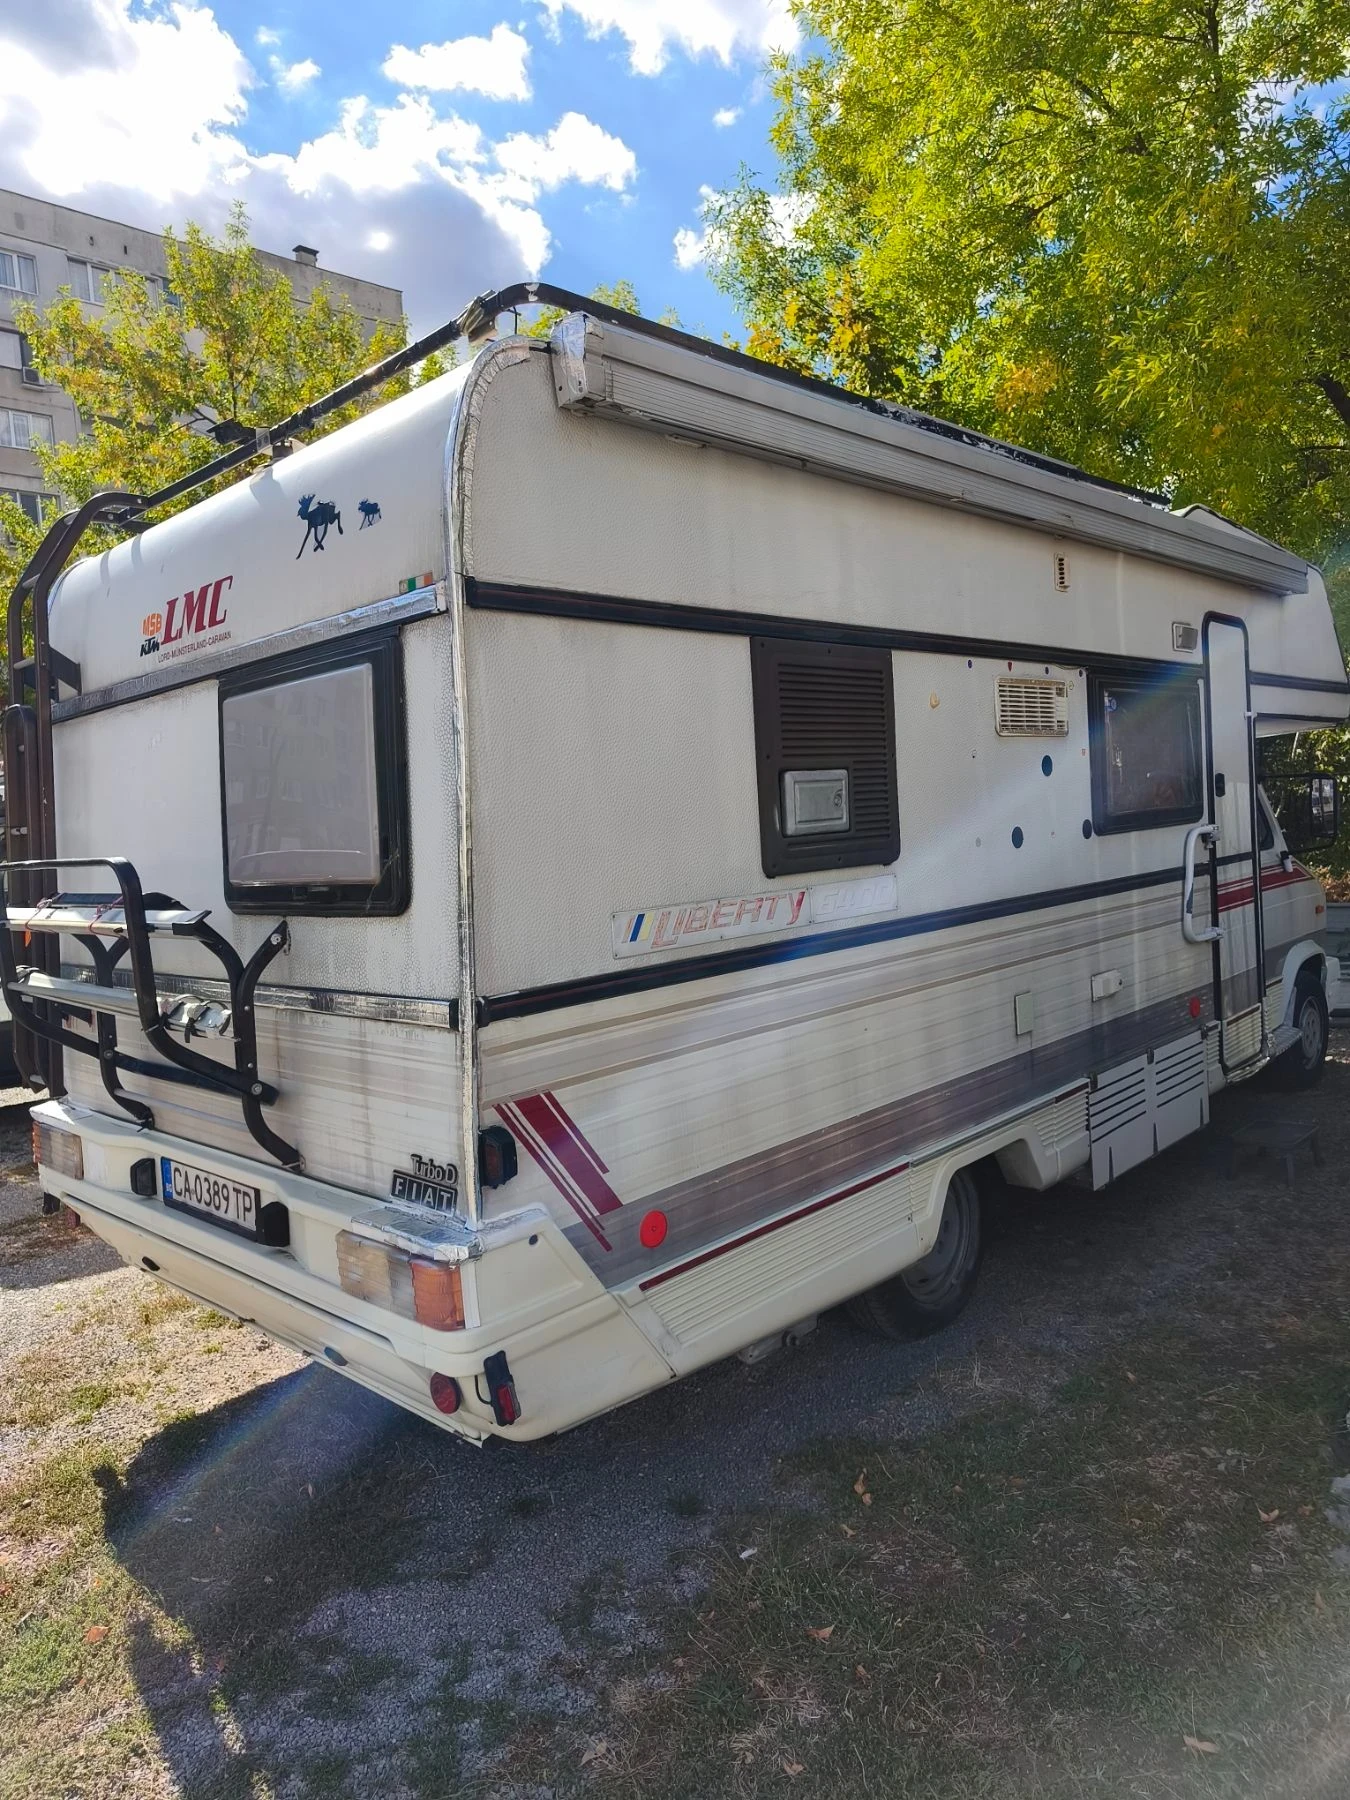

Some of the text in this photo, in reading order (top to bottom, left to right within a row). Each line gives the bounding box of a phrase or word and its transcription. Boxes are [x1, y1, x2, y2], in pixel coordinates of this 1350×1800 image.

[161, 575, 233, 645] LMC
[140, 636, 160, 657] KTM
[651, 891, 806, 949] LIBERTY
[411, 1154, 458, 1186] Turbo D
[394, 1177, 451, 1210] FIAT
